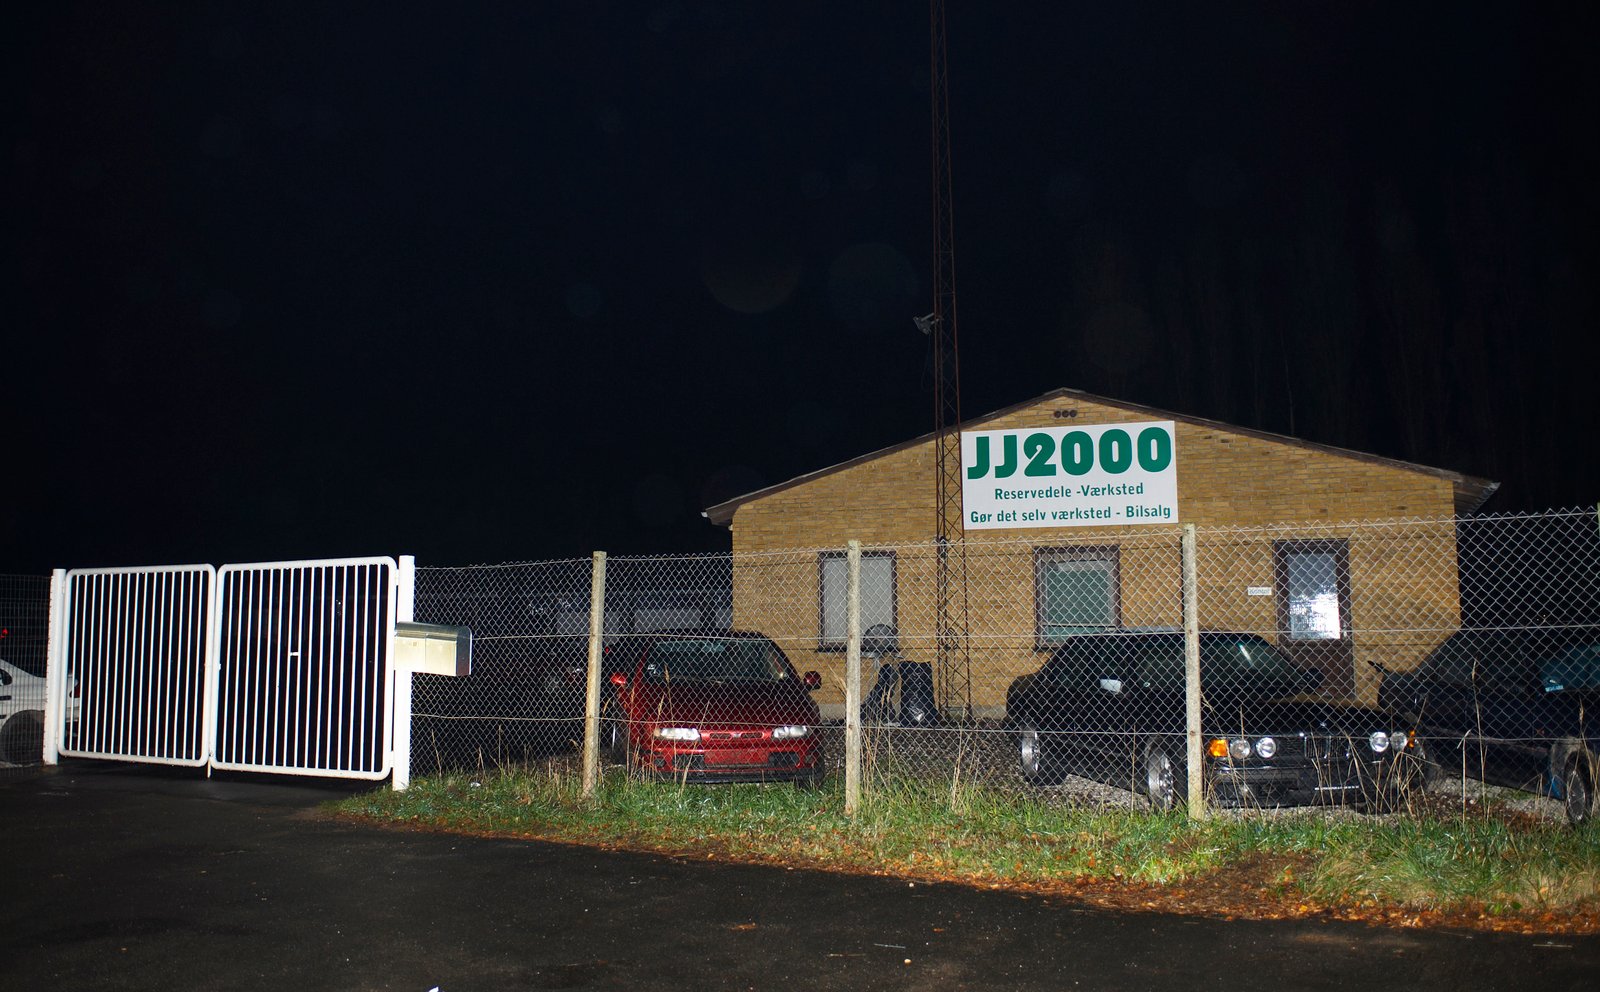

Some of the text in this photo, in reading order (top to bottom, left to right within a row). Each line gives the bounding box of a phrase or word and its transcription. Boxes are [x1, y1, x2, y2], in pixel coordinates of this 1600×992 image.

[966, 426, 1171, 479] JJ2000
[994, 487, 1072, 500] Reservedele
[970, 511, 992, 524] Gør
[997, 509, 1018, 522] det
[1022, 508, 1046, 521] selv
[1051, 506, 1112, 520] værksted
[1126, 504, 1171, 519] Bilsalg
